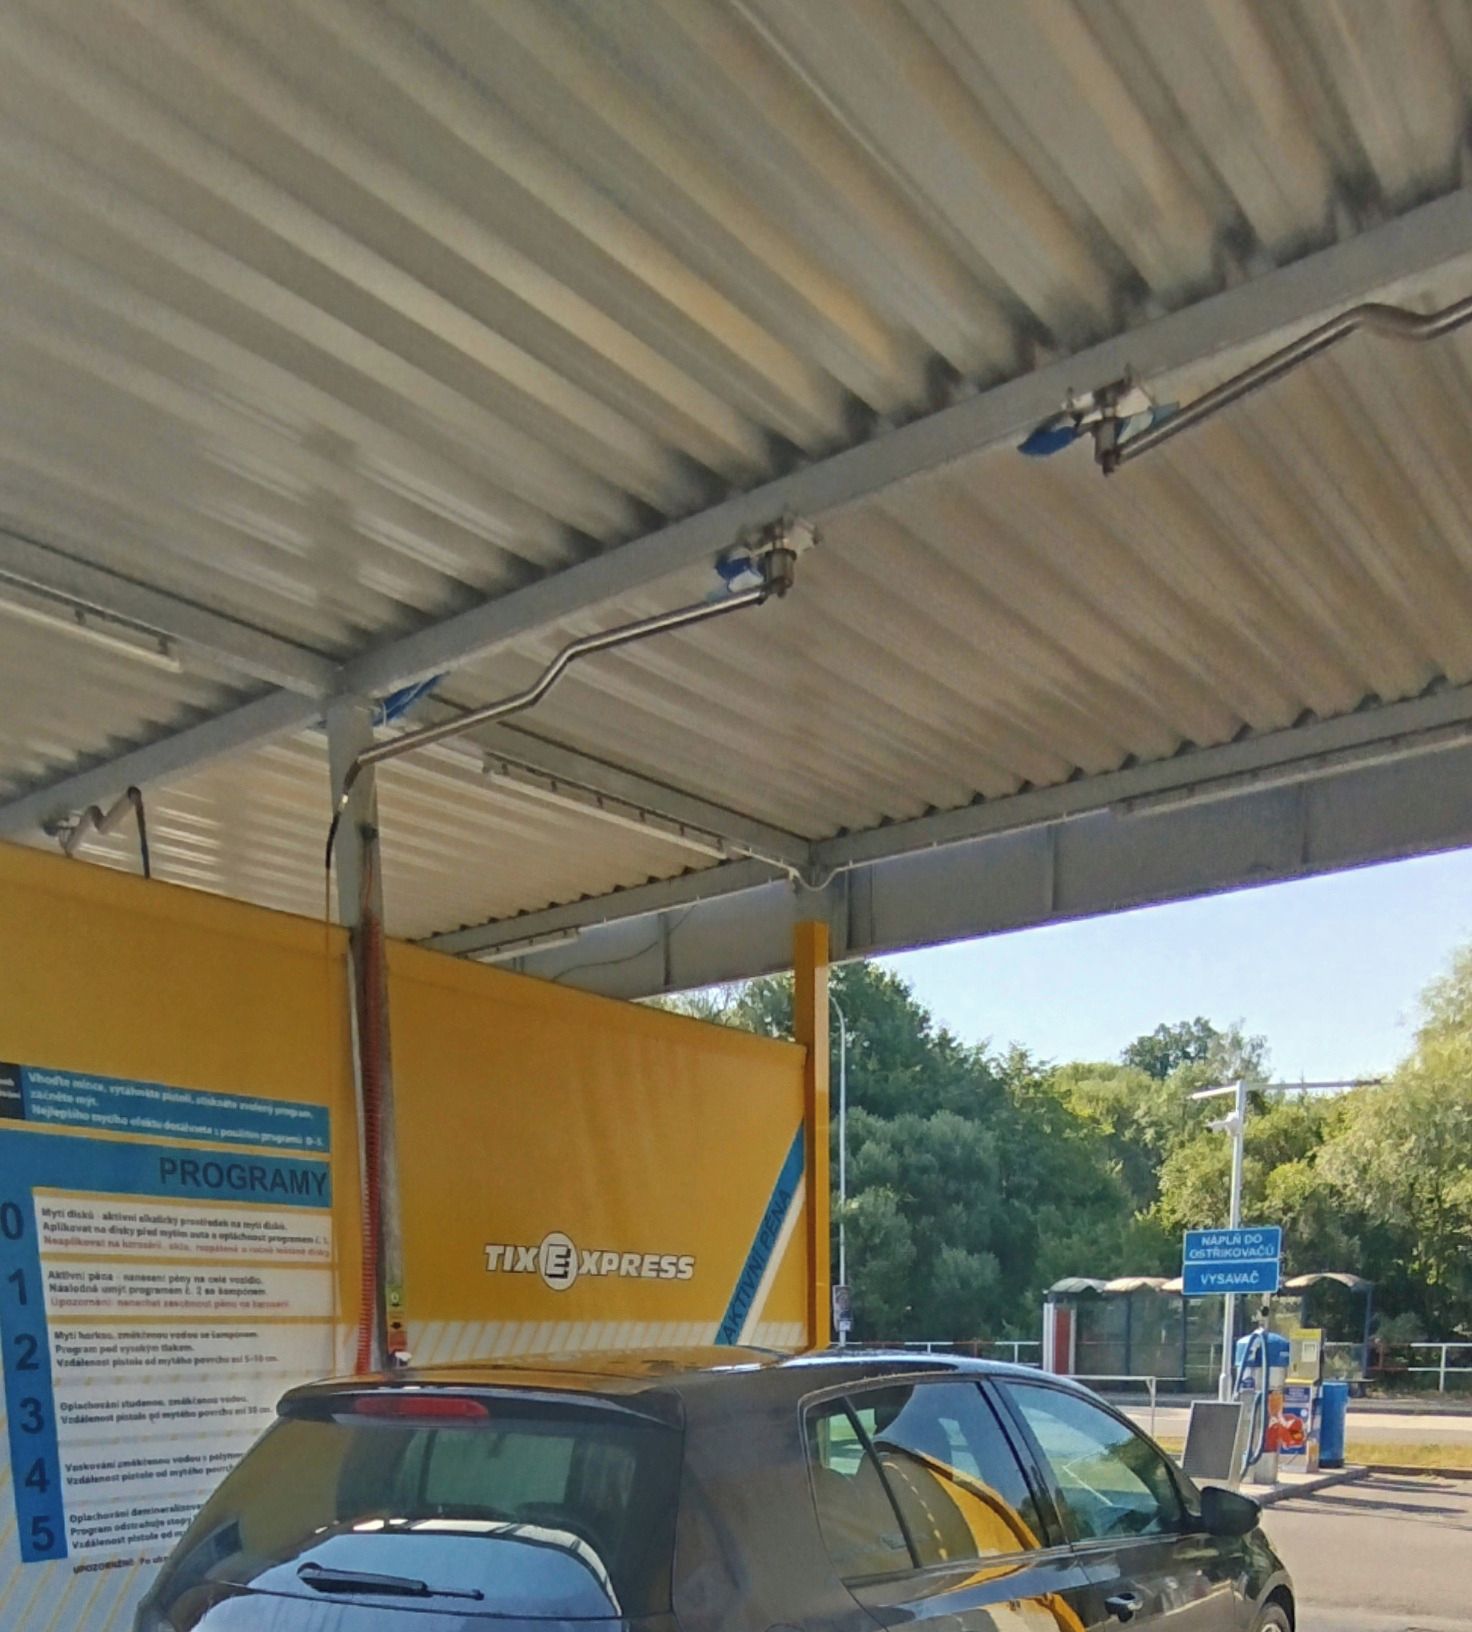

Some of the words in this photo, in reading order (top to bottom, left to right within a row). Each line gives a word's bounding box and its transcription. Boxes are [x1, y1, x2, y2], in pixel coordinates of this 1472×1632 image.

[159, 1157, 327, 1196] PROGRAMY
[1, 1202, 24, 1240] 0
[42, 1208, 65, 1219] Mytí
[67, 1208, 94, 1219] disků
[230, 1219, 241, 1228] na
[43, 1222, 92, 1234] Aplikovat
[94, 1225, 106, 1234] na
[109, 1224, 135, 1236] disky
[137, 1226, 157, 1237] před
[1201, 1233, 1241, 1246] NÁPLŇ
[1244, 1233, 1263, 1244] DO
[88, 1271, 113, 1283] pěna
[1200, 1270, 1260, 1284] VYSAVAČ
[9, 1268, 27, 1305] 1
[129, 1285, 182, 1296] programem
[54, 1331, 76, 1341] Mytí
[170, 1331, 198, 1340] vodou
[14, 1333, 39, 1370] 2
[56, 1344, 97, 1355] Program
[100, 1344, 117, 1355] pod
[119, 1344, 159, 1354] vysokým
[57, 1358, 109, 1367] Vzdálenost
[112, 1357, 143, 1367] pistole
[145, 1356, 156, 1365] od
[158, 1355, 192, 1367] mytého
[60, 1400, 119, 1411] Oplachování
[20, 1397, 45, 1434] 3
[61, 1414, 113, 1424] Vzdálenost
[116, 1412, 146, 1423] pistole
[162, 1409, 196, 1419] mytého
[65, 1461, 116, 1472] Voskování
[172, 1454, 201, 1463] vodou
[25, 1457, 50, 1493] 4
[66, 1474, 119, 1485] Vzdálenost
[122, 1471, 154, 1482] pistole
[155, 1469, 167, 1478] od
[169, 1466, 203, 1477] mytého
[70, 1508, 129, 1523] Oplachování
[31, 1515, 55, 1551] 5
[71, 1526, 112, 1537] Program
[72, 1536, 125, 1549] Vzdálenost
[127, 1532, 159, 1544] pistole
[161, 1530, 172, 1540] od
